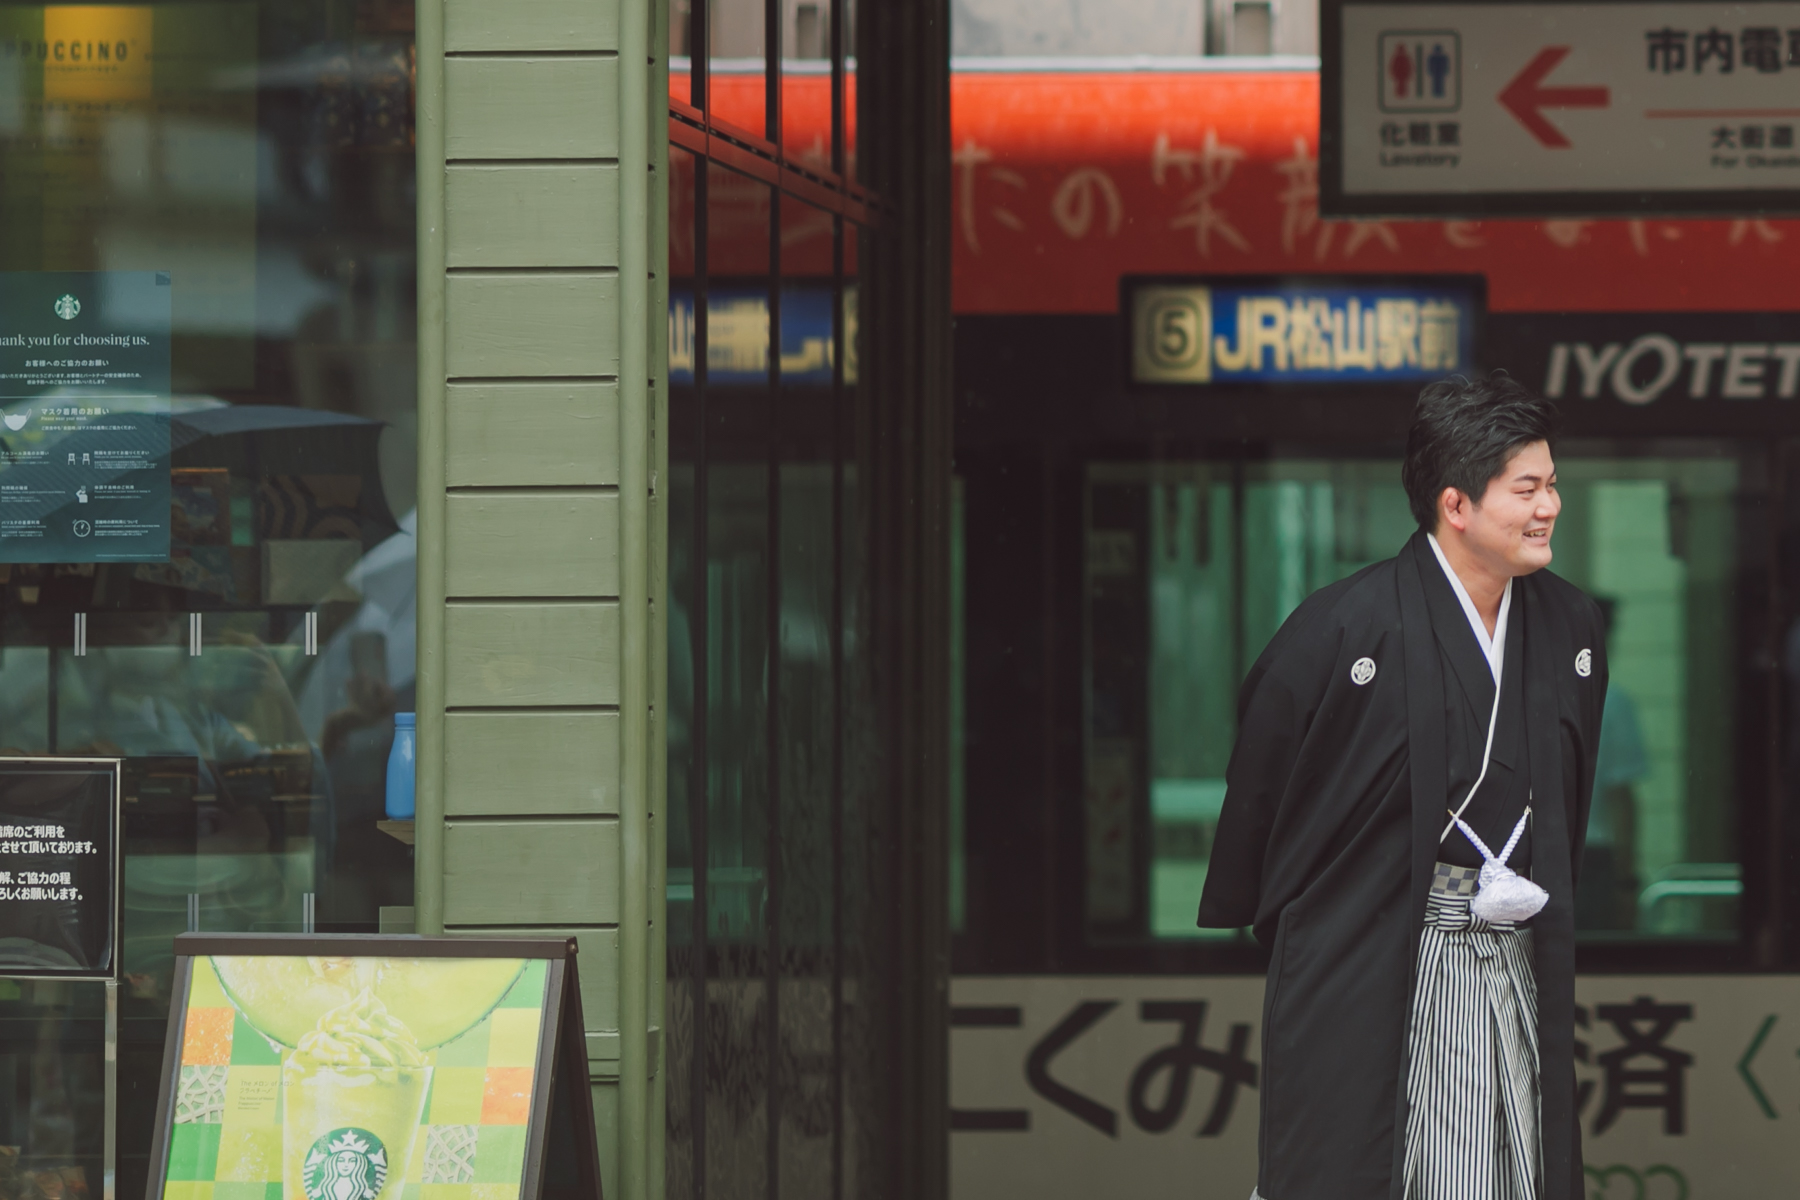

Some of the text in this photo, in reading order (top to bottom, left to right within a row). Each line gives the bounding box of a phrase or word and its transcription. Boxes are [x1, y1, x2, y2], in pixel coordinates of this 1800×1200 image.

[1379, 121, 1461, 147] 化粧室
[1380, 150, 1461, 169] Lavatory
[27, 337, 51, 348] you
[53, 333, 71, 346] for
[73, 333, 131, 348] choosing
[132, 337, 150, 346] us.
[0, 841, 97, 854] させて頂いております。
